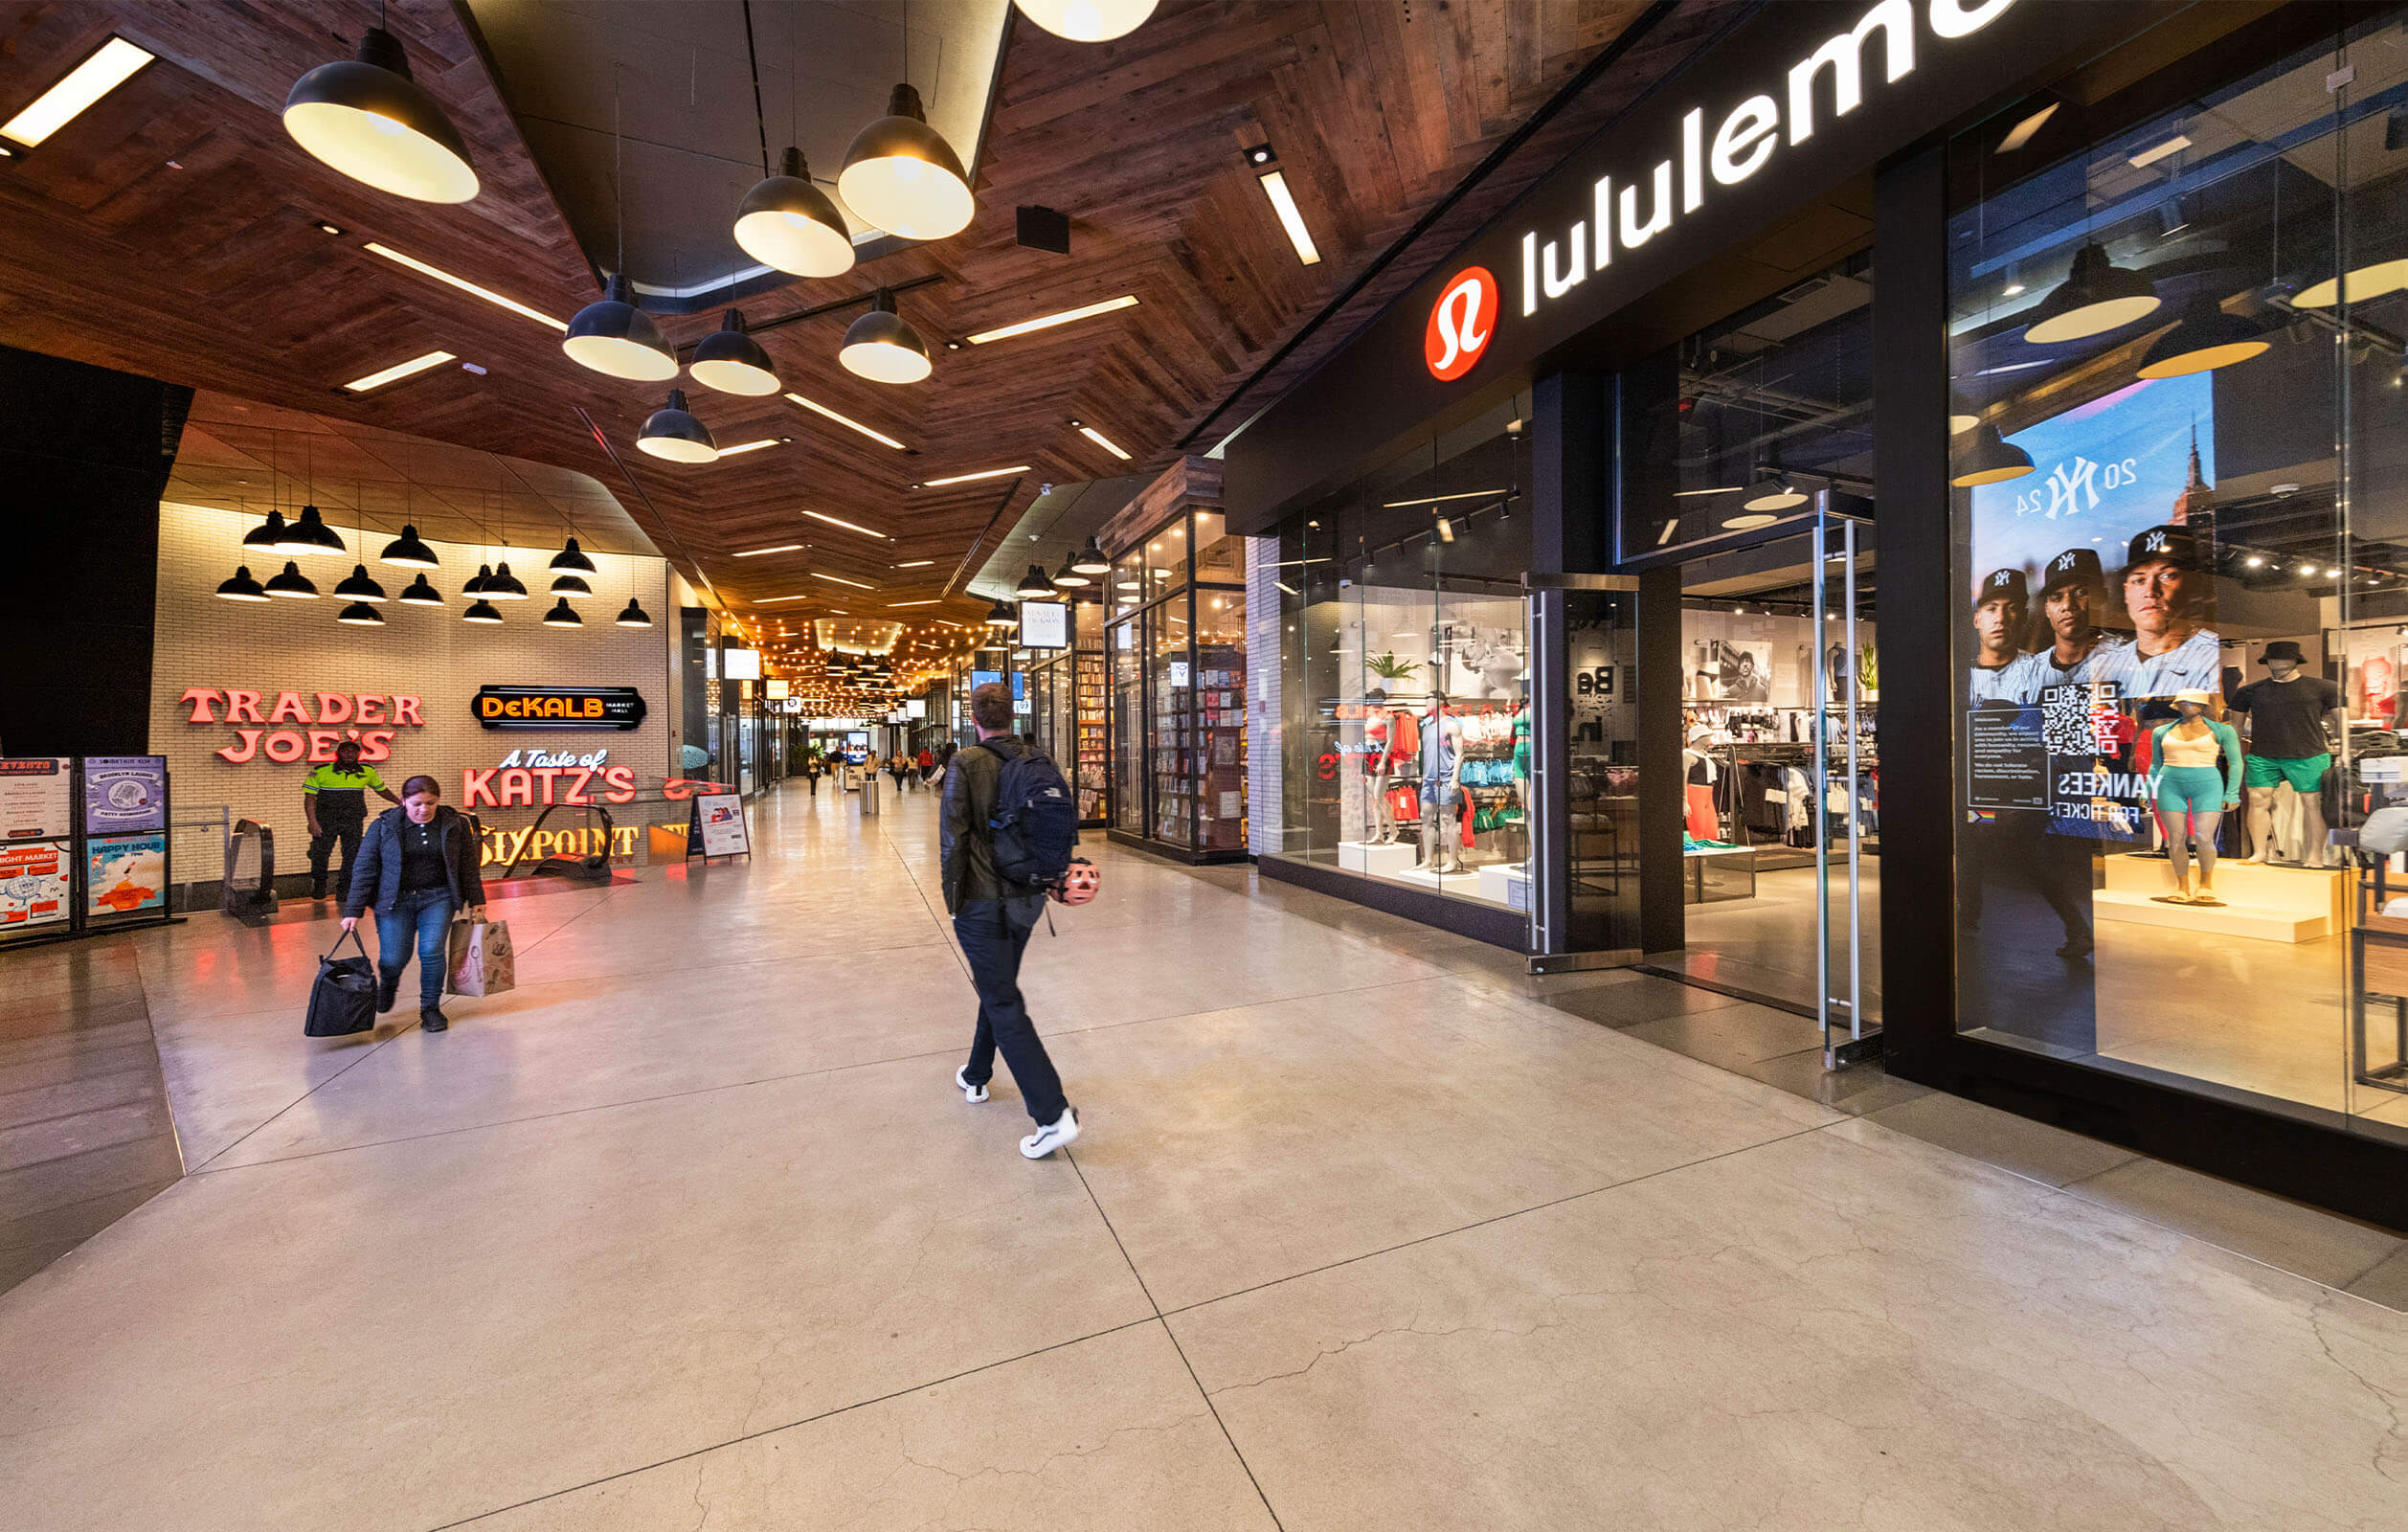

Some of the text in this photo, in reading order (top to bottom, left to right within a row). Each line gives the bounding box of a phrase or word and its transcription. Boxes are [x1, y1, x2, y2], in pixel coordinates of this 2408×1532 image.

[179, 687, 426, 726] TRADER
[214, 729, 396, 763] JOE'S
[499, 749, 608, 772] A Taste of
[462, 766, 636, 808] KATZ'S
[92, 842, 161, 854] HAPPY HOUR
